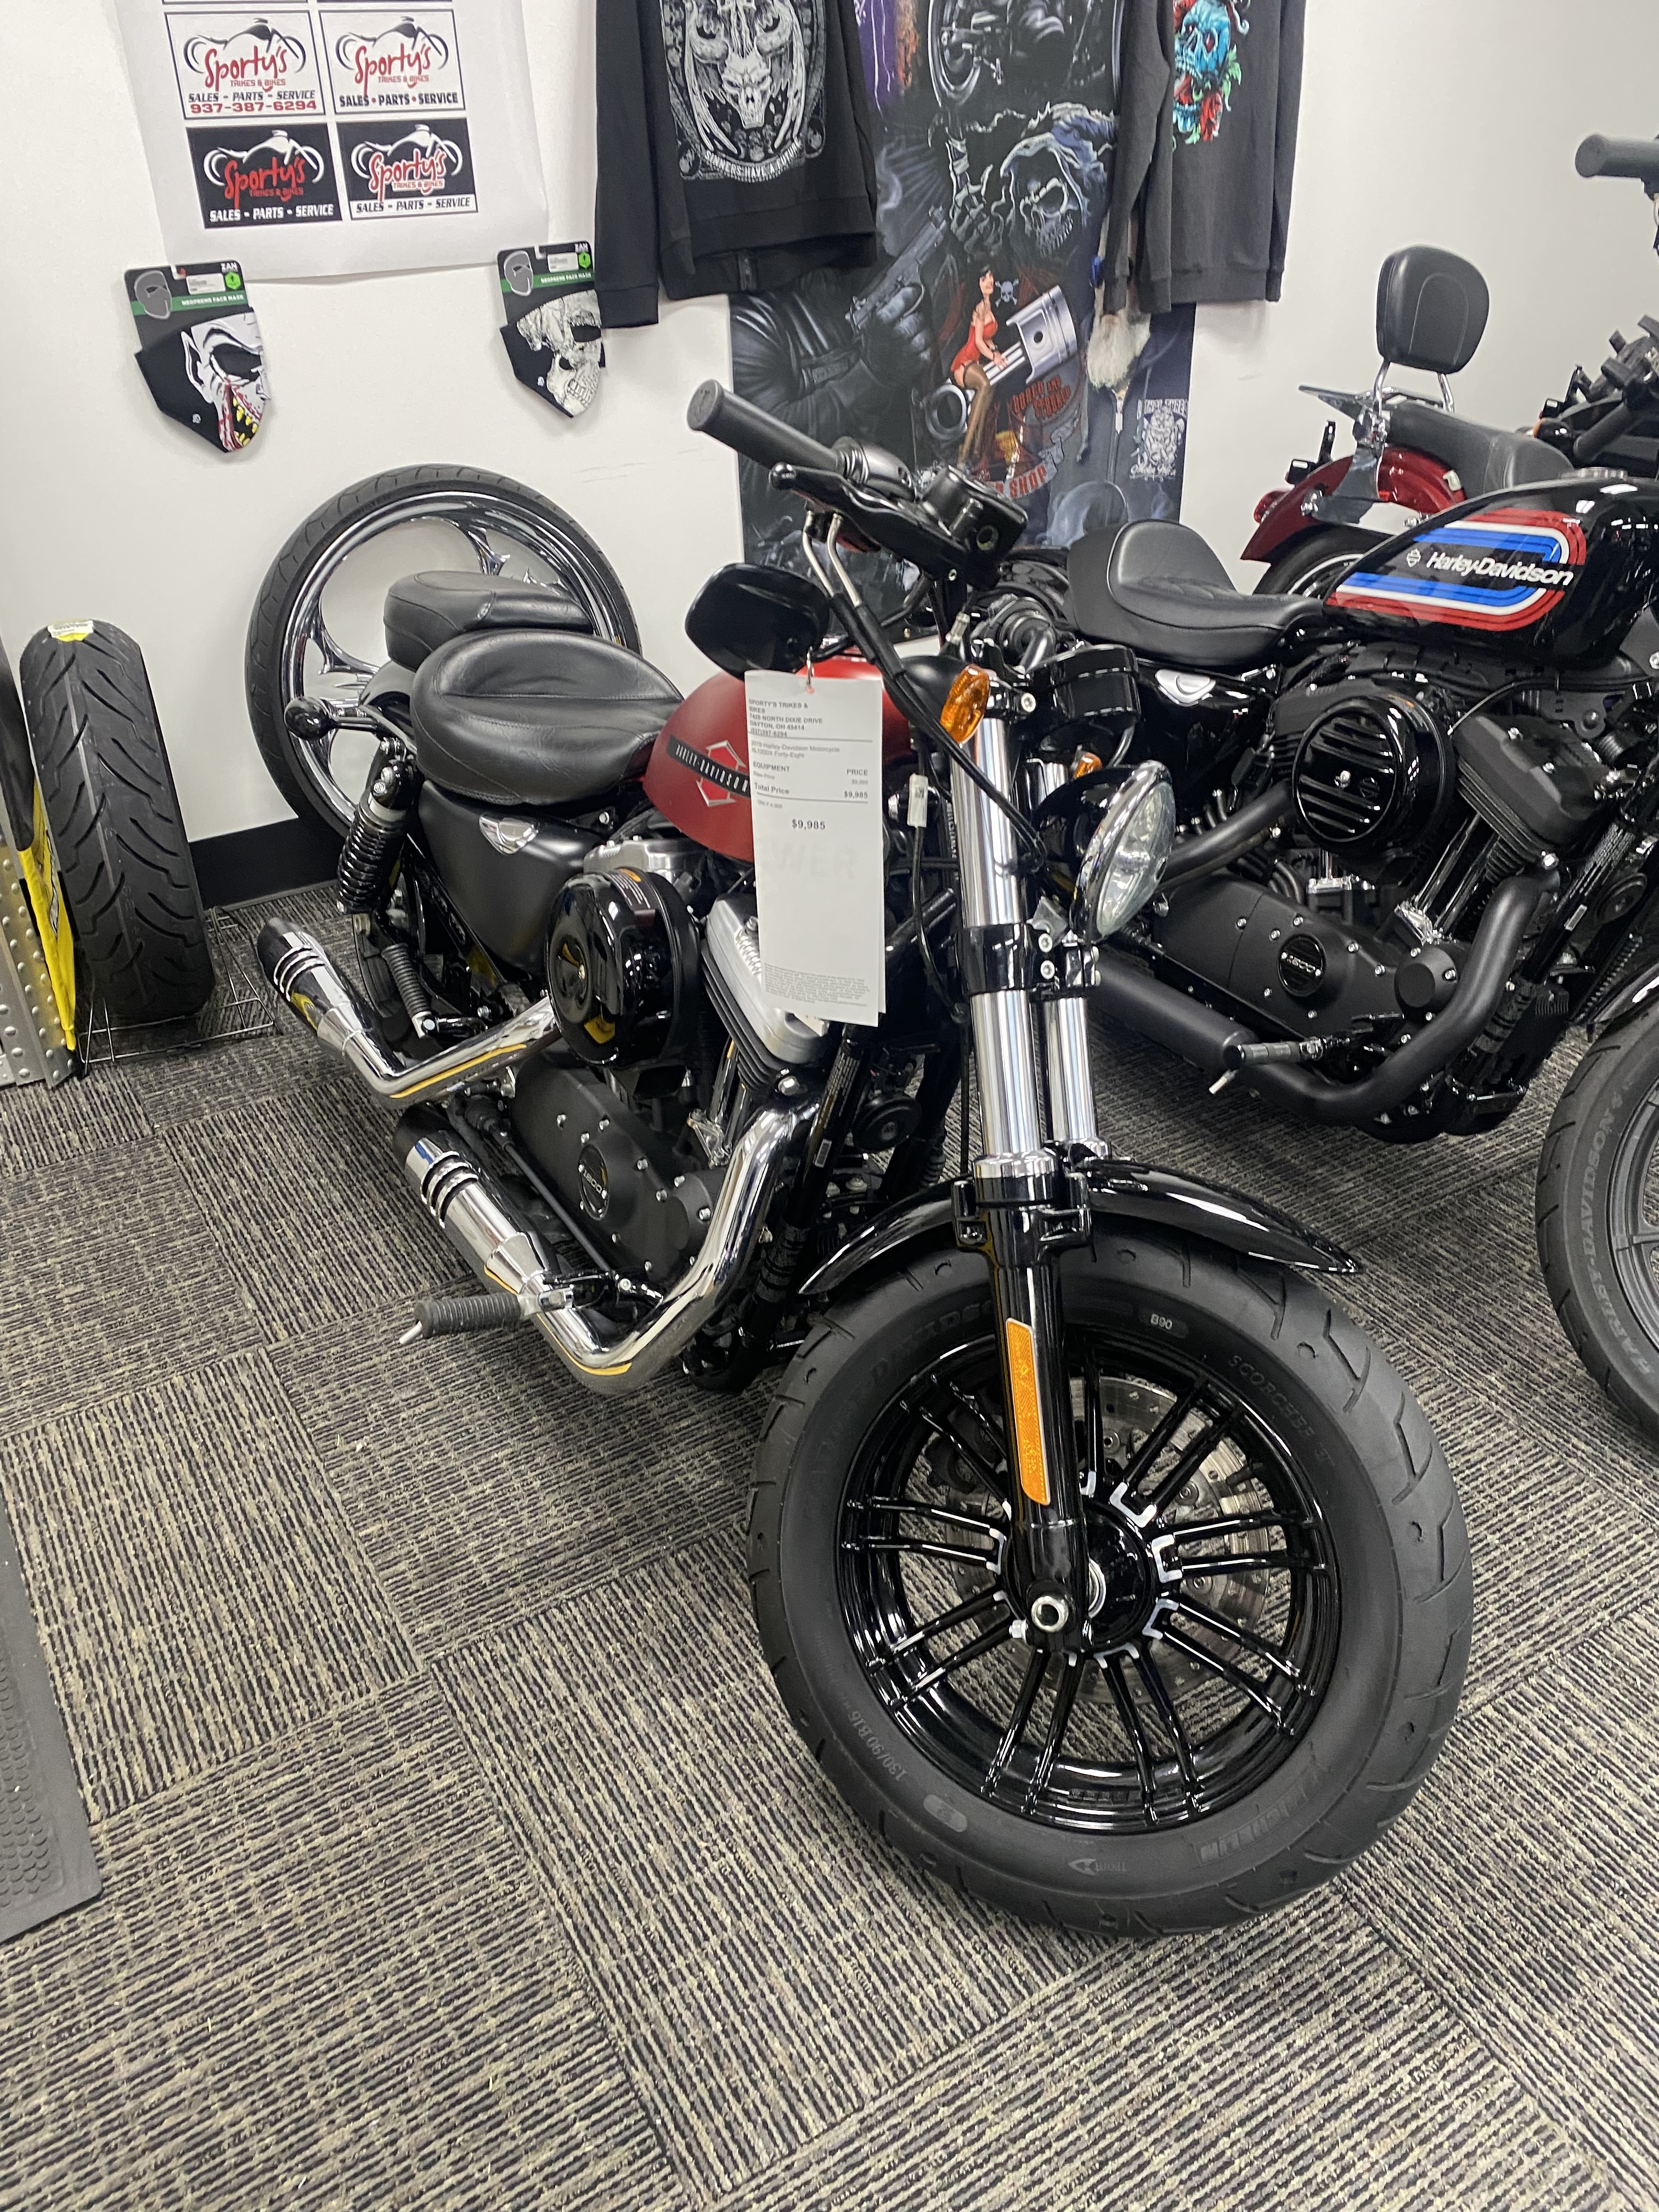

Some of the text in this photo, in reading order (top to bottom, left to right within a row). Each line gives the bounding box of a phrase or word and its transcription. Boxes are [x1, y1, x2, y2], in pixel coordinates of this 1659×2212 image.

[205, 46, 287, 92] Sporty's
[354, 43, 431, 95] Sporty's
[188, 93, 219, 103] SALES
[233, 92, 263, 101] PARTS
[276, 90, 315, 99] SERVICE
[339, 92, 458, 107] SALES PARTS SERVICE
[190, 100, 317, 114] 937-387-6294
[704, 149, 742, 176] SINNERS
[224, 157, 305, 210] Sporty's
[370, 150, 445, 202] Sporty's
[210, 209, 241, 222] SALES
[253, 207, 284, 219] PARTS
[296, 204, 334, 217] SERVICE
[357, 202, 383, 213] SALES
[396, 200, 424, 211] PARTS
[436, 197, 470, 208] SERVICE
[1009, 464, 1047, 499] SHOP
[1427, 551, 1575, 586] Harley-Davidson
[749, 699, 777, 708] SPORTY'S
[750, 720, 775, 730] DAYTON,
[763, 715, 784, 723] NORTH
[753, 761, 790, 772] EQUIPMENT
[754, 782, 868, 799] Total Price $9,985
[792, 818, 825, 830] $9,985
